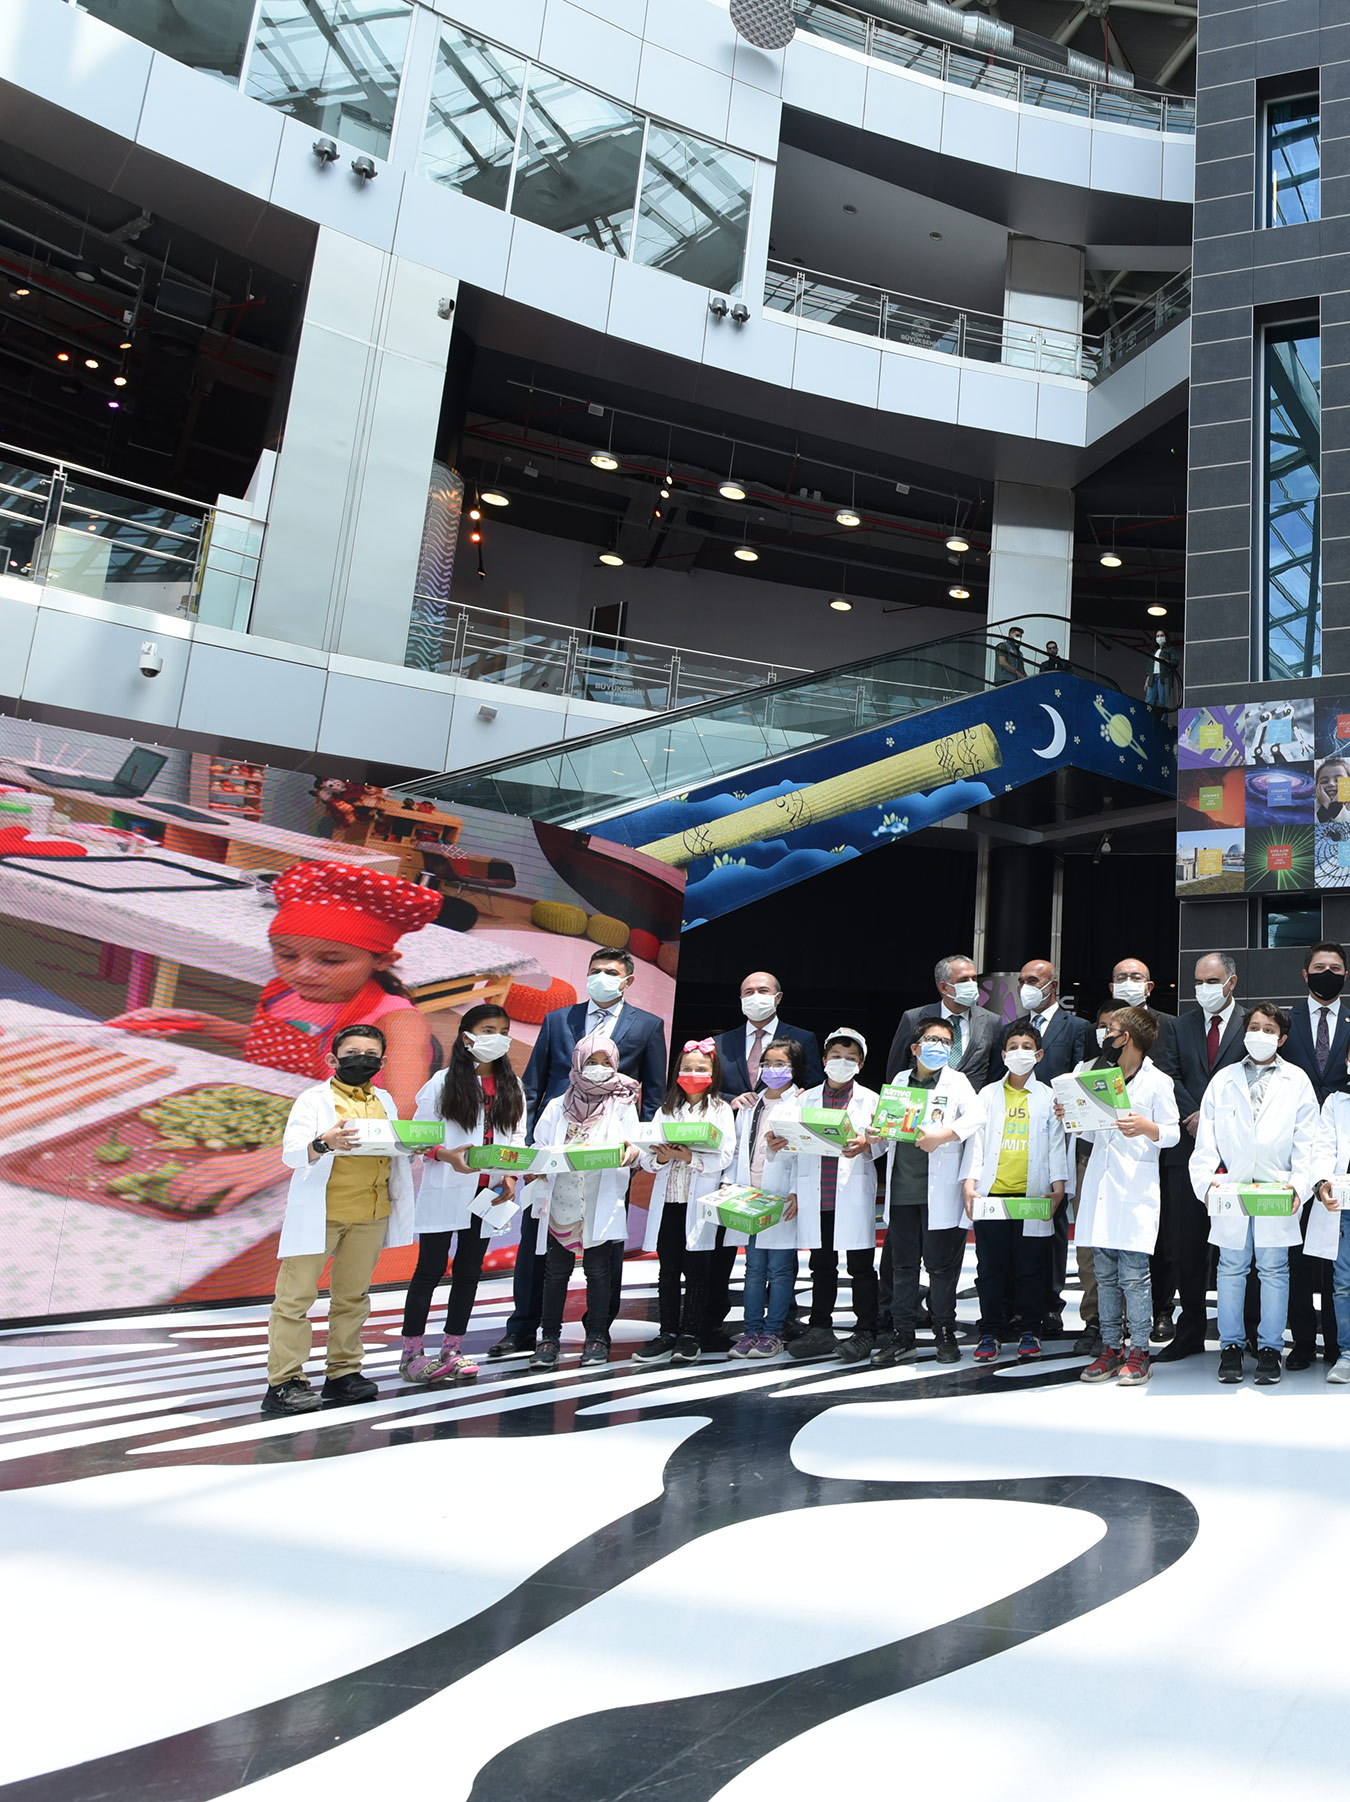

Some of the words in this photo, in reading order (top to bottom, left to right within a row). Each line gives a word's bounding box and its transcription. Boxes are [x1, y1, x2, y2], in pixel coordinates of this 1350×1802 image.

[1008, 1108, 1026, 1119] US
[1006, 1122, 1027, 1134] OU
[1001, 1139, 1029, 1151] MIT
